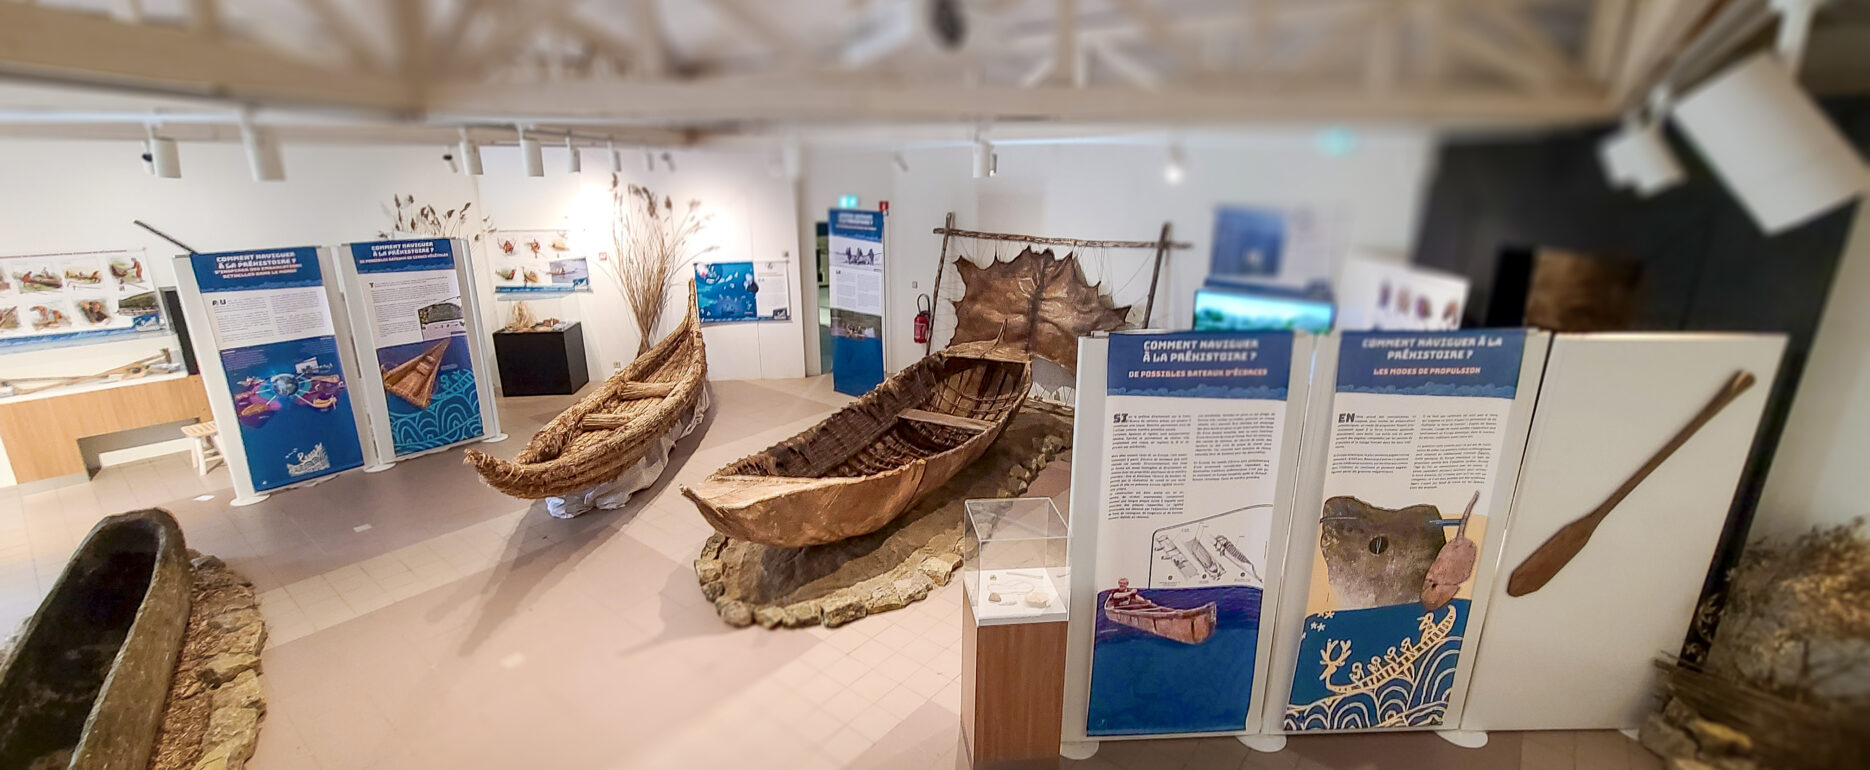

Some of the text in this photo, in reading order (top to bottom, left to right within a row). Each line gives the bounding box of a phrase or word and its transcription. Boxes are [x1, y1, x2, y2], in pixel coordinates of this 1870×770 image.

[1144, 339, 1259, 351] COMMENT NAVIGUER
[1362, 336, 1503, 349] COMMENT NAVIGUER À LA
[1143, 350, 1258, 363] À LA PRÉHISTOIRE ?
[1387, 349, 1474, 360] PRÉHISTOIRE ?
[1129, 371, 1140, 379] DE
[1140, 370, 1186, 378] POSSIBLES
[1187, 369, 1224, 378] BATEAUX
[1373, 368, 1389, 376] LES
[1390, 368, 1417, 376] MODES
[1430, 367, 1481, 375] PROPULSION
[1113, 413, 1129, 424] SI
[1338, 413, 1355, 423] EN
